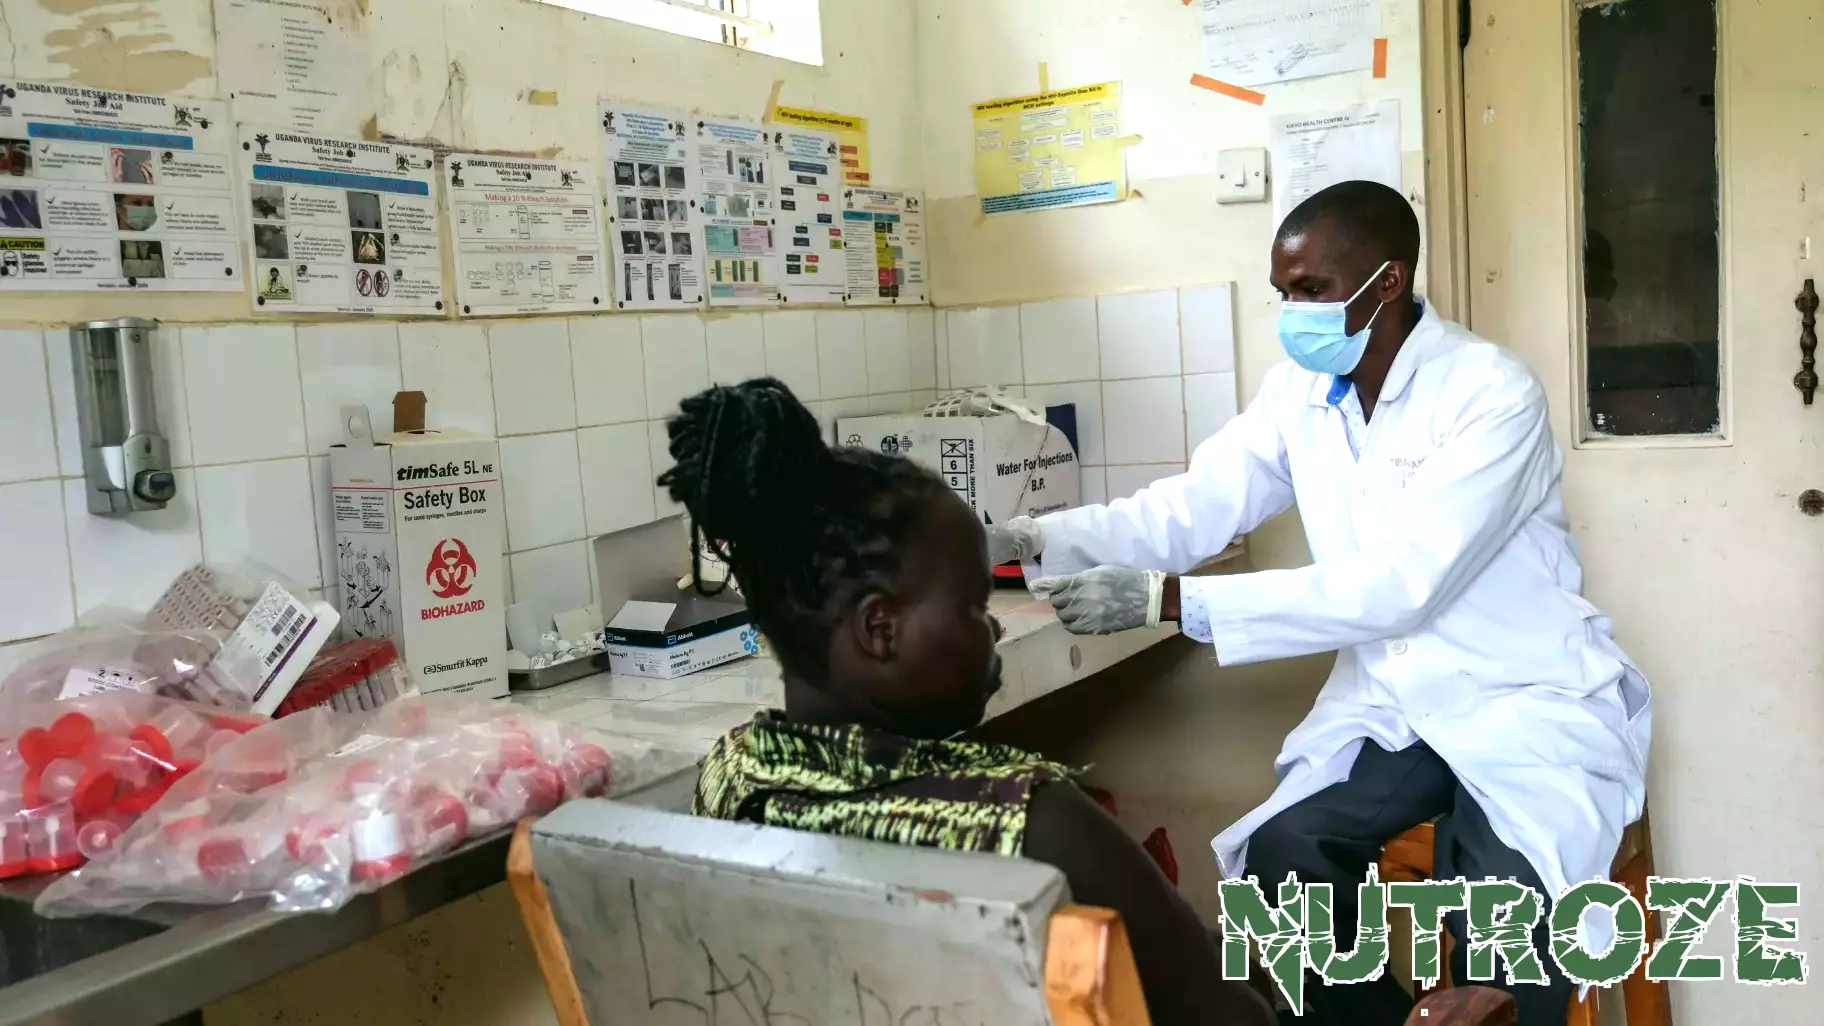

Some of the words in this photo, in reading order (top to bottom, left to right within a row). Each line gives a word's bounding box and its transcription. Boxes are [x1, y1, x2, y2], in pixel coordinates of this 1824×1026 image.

[16, 82, 52, 94] UGANDA
[53, 86, 80, 97] VIRUS
[65, 98, 90, 108] Safety
[275, 133, 302, 143] UGANDA
[303, 137, 323, 146] VIRUS
[324, 139, 357, 150] RESEARCH
[358, 143, 390, 154] INSTITUTE
[312, 146, 331, 156] Safety
[333, 148, 344, 156] Job
[467, 159, 488, 167] UGANDA
[489, 161, 504, 169] VIRUS
[505, 162, 531, 170] RESEARCH
[532, 164, 557, 172] INSTITUTE
[495, 169, 511, 177] Safety
[485, 193, 507, 202] Making
[8, 240, 45, 248] CAUTION
[396, 461, 460, 481] timSafe
[463, 460, 479, 475] 5L
[482, 464, 493, 474] NE
[950, 460, 957, 470] 6
[996, 461, 1022, 477] Water
[1023, 458, 1036, 471] For
[1038, 451, 1073, 470] Injections
[951, 476, 958, 486] 5
[1031, 478, 1046, 492] B.P.
[403, 489, 453, 510] Safety
[459, 486, 486, 504] Box
[425, 512, 445, 520] syringes,
[473, 507, 487, 516] sharps
[421, 599, 485, 620] BIOHAZARD
[677, 631, 694, 641] Abbott
[436, 659, 465, 673] Smurfit
[465, 656, 488, 668] Kappa
